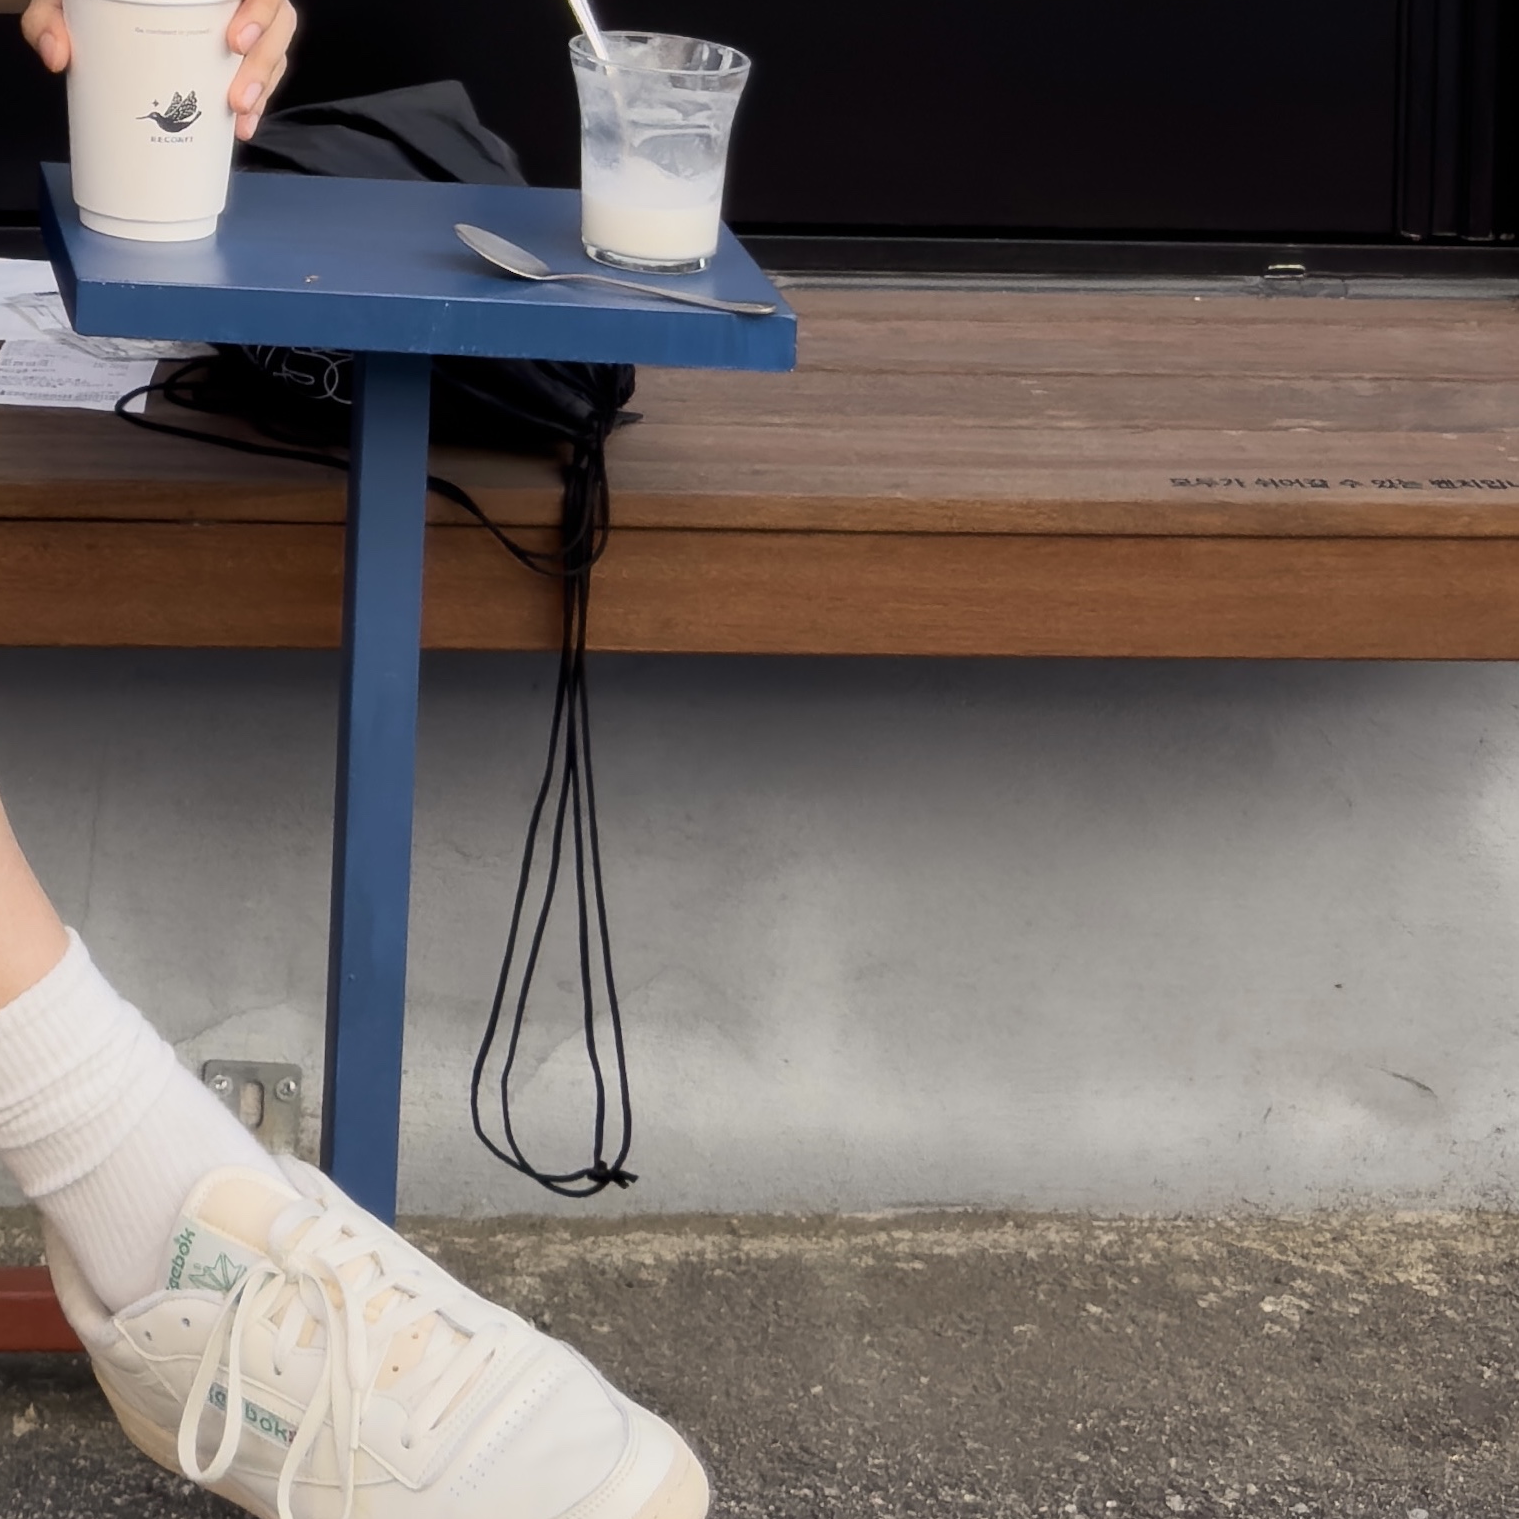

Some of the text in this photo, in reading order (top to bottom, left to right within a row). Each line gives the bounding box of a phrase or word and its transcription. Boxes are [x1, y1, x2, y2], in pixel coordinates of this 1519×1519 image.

[1169, 477, 1246, 489] 모두가
[1254, 477, 1330, 489] 쉬어갈
[1339, 478, 1364, 489] 수
[1371, 478, 1423, 490] 있는
